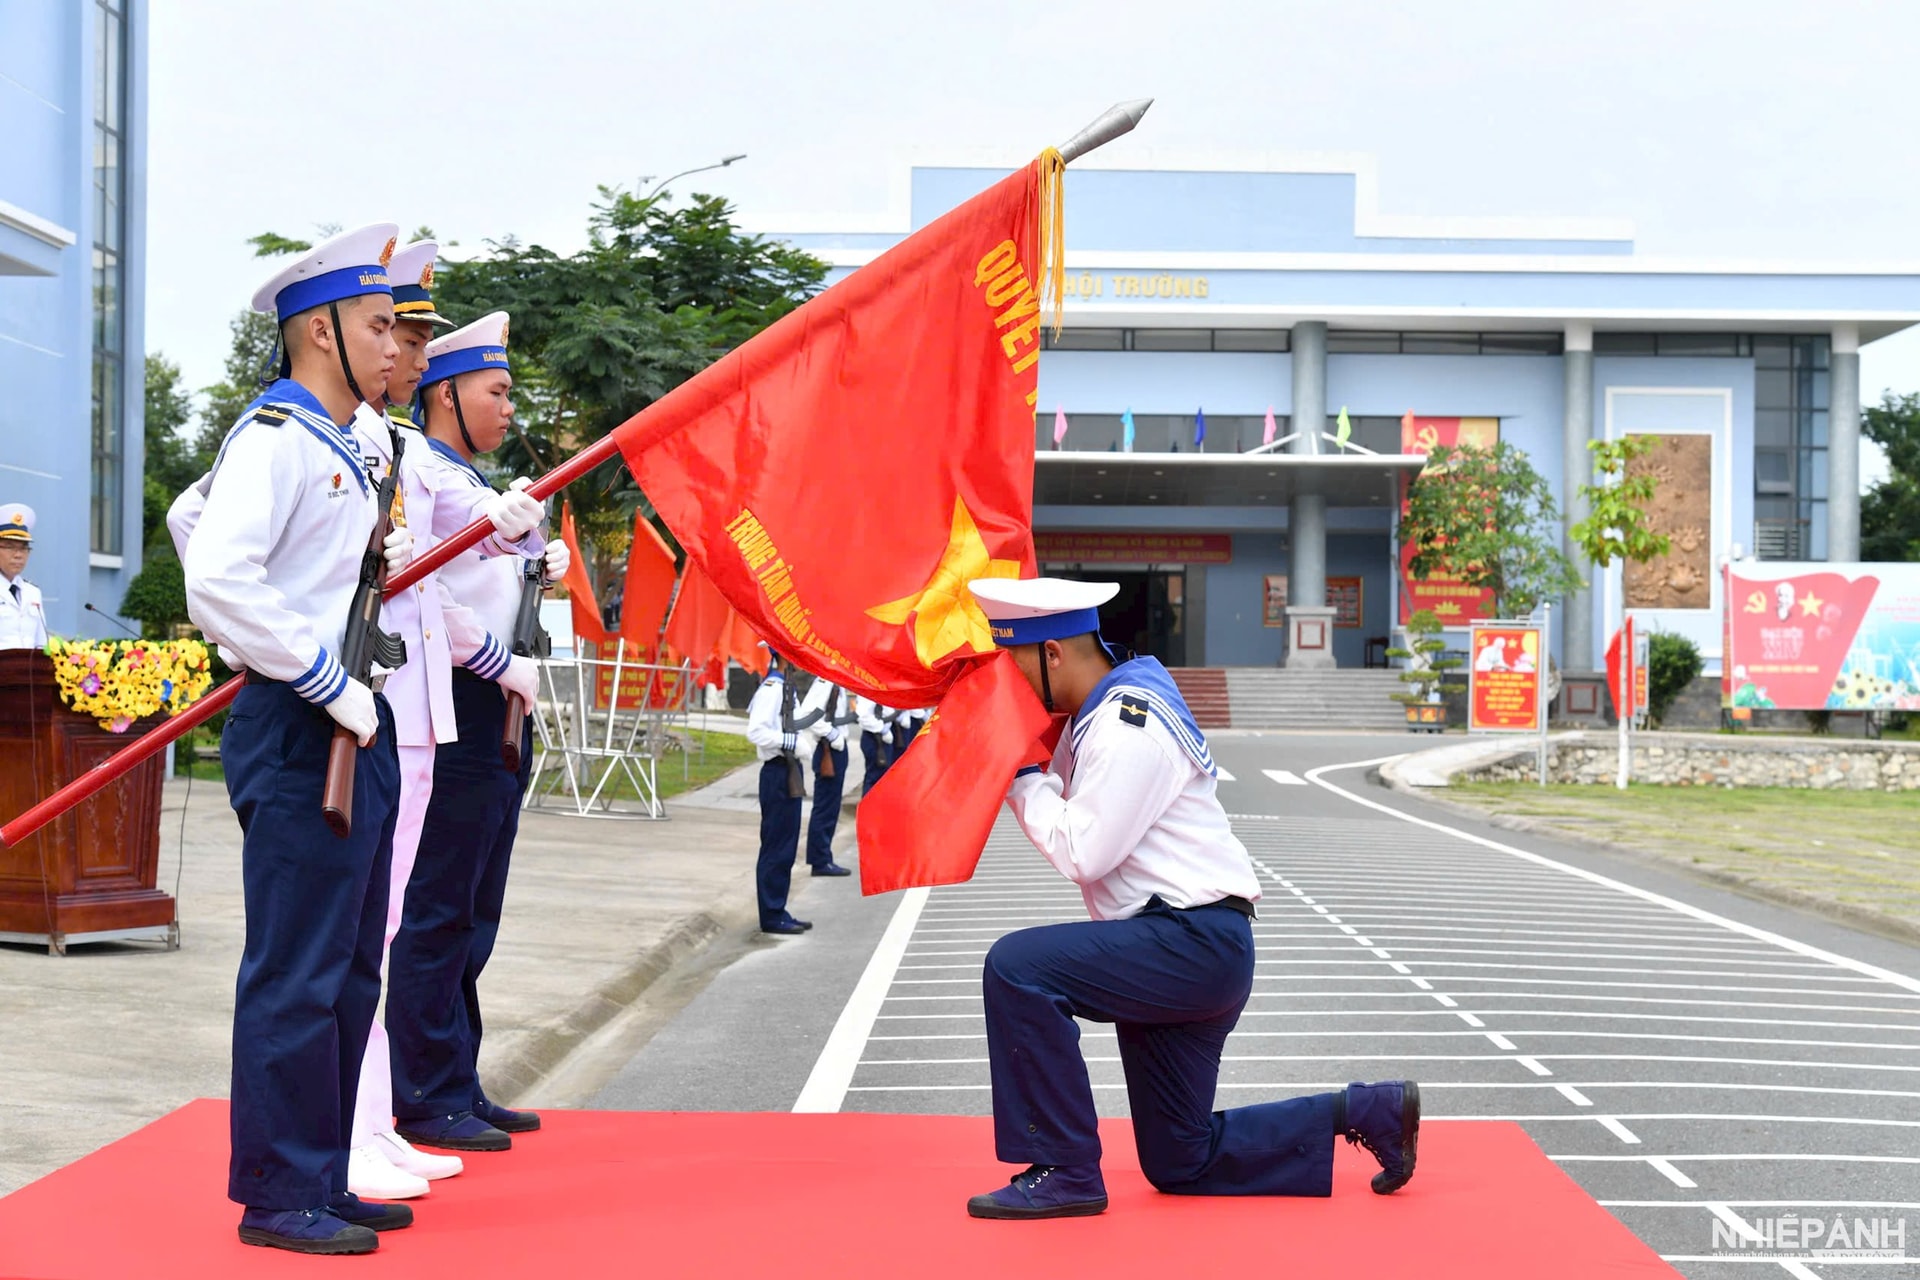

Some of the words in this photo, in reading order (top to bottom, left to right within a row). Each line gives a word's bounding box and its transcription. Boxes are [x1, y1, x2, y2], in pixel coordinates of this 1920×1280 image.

[1062, 270, 1103, 301] HỘI
[1112, 271, 1209, 298] TRƯỜNG
[725, 508, 778, 571] TRUNG
[758, 557, 794, 605] TÂM
